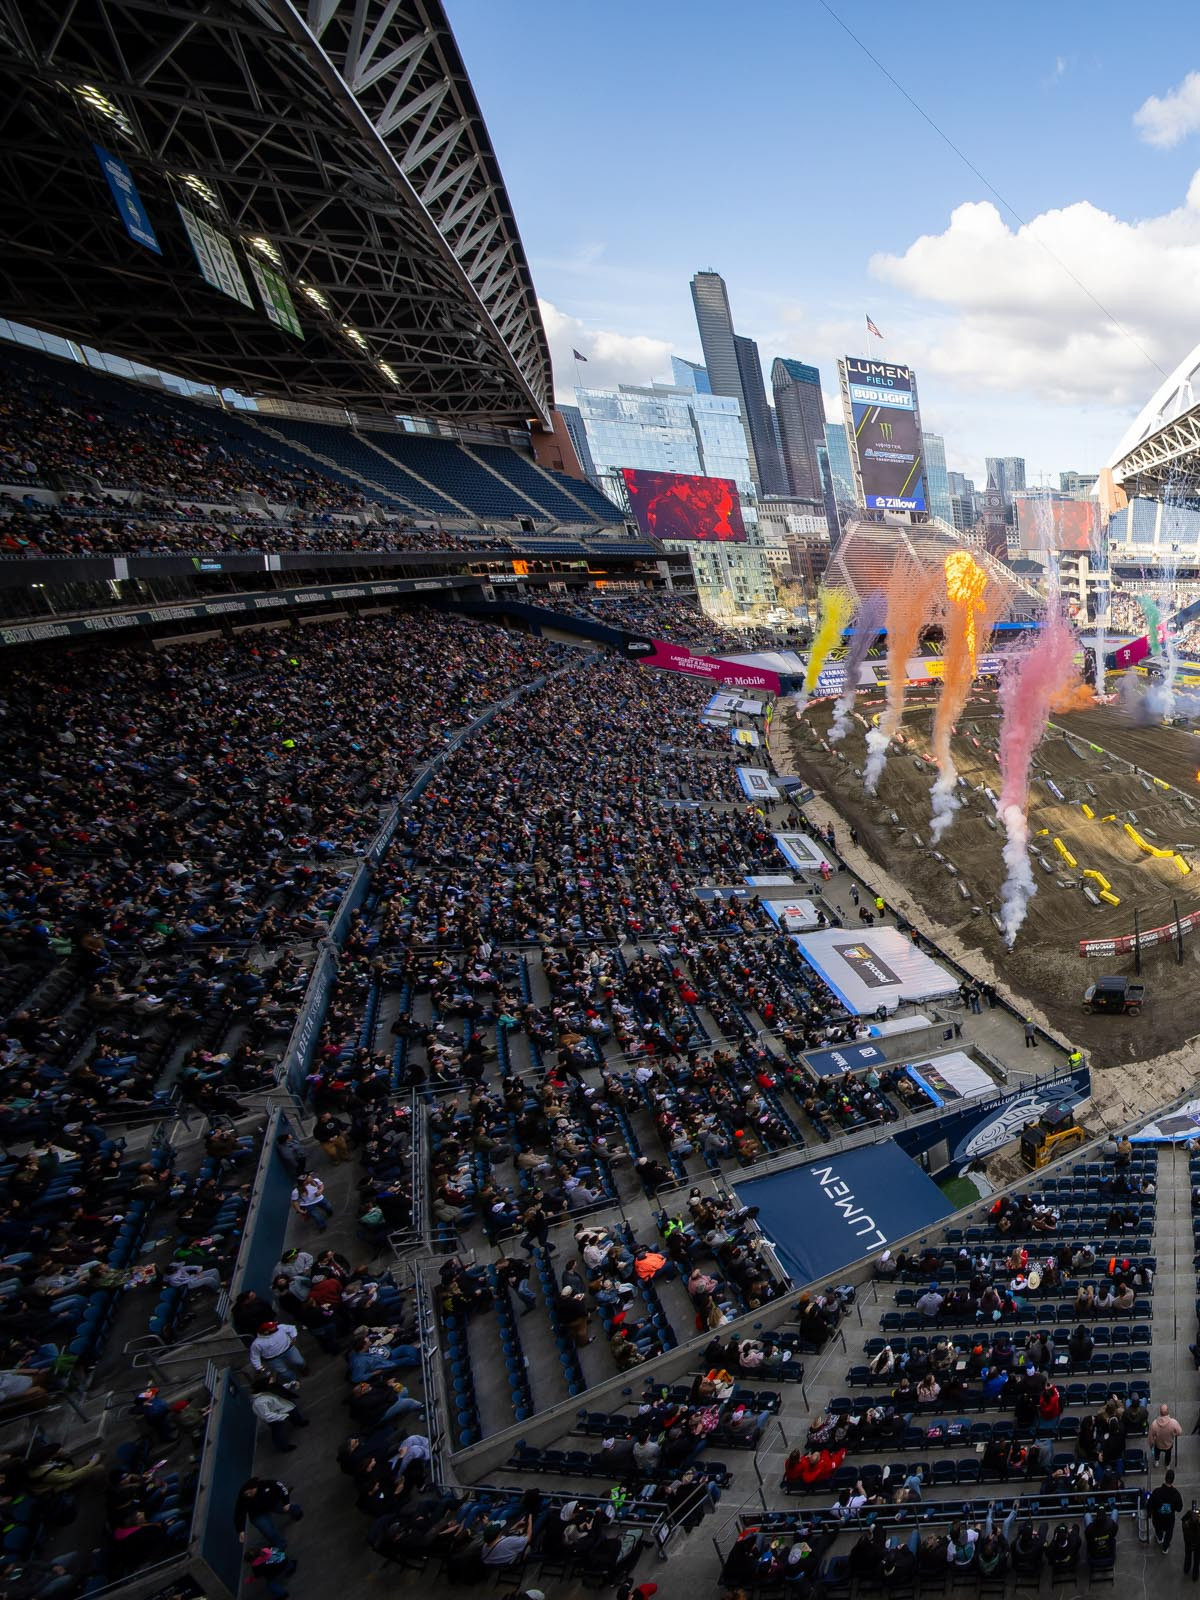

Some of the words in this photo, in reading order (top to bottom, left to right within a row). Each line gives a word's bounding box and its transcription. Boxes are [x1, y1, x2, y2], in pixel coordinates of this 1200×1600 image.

[846, 359, 910, 380] LUMEN
[866, 376, 894, 387] FIELD
[853, 388, 878, 401] BUD
[878, 391, 909, 405] LIGHT
[886, 497, 916, 509] Zillow
[1, 630, 16, 644] 28
[670, 655, 694, 666] LARGEST
[685, 662, 712, 673] NETWORK
[734, 676, 766, 686] Mobile
[818, 687, 843, 697] YAMAHA
[861, 960, 894, 983] peacock
[299, 1016, 314, 1056] DELTA
[1016, 1089, 1035, 1101] TRIBE
[1036, 1084, 1046, 1094] OF
[1046, 1076, 1073, 1090] INDIANS
[812, 1166, 888, 1251] LUMEN
